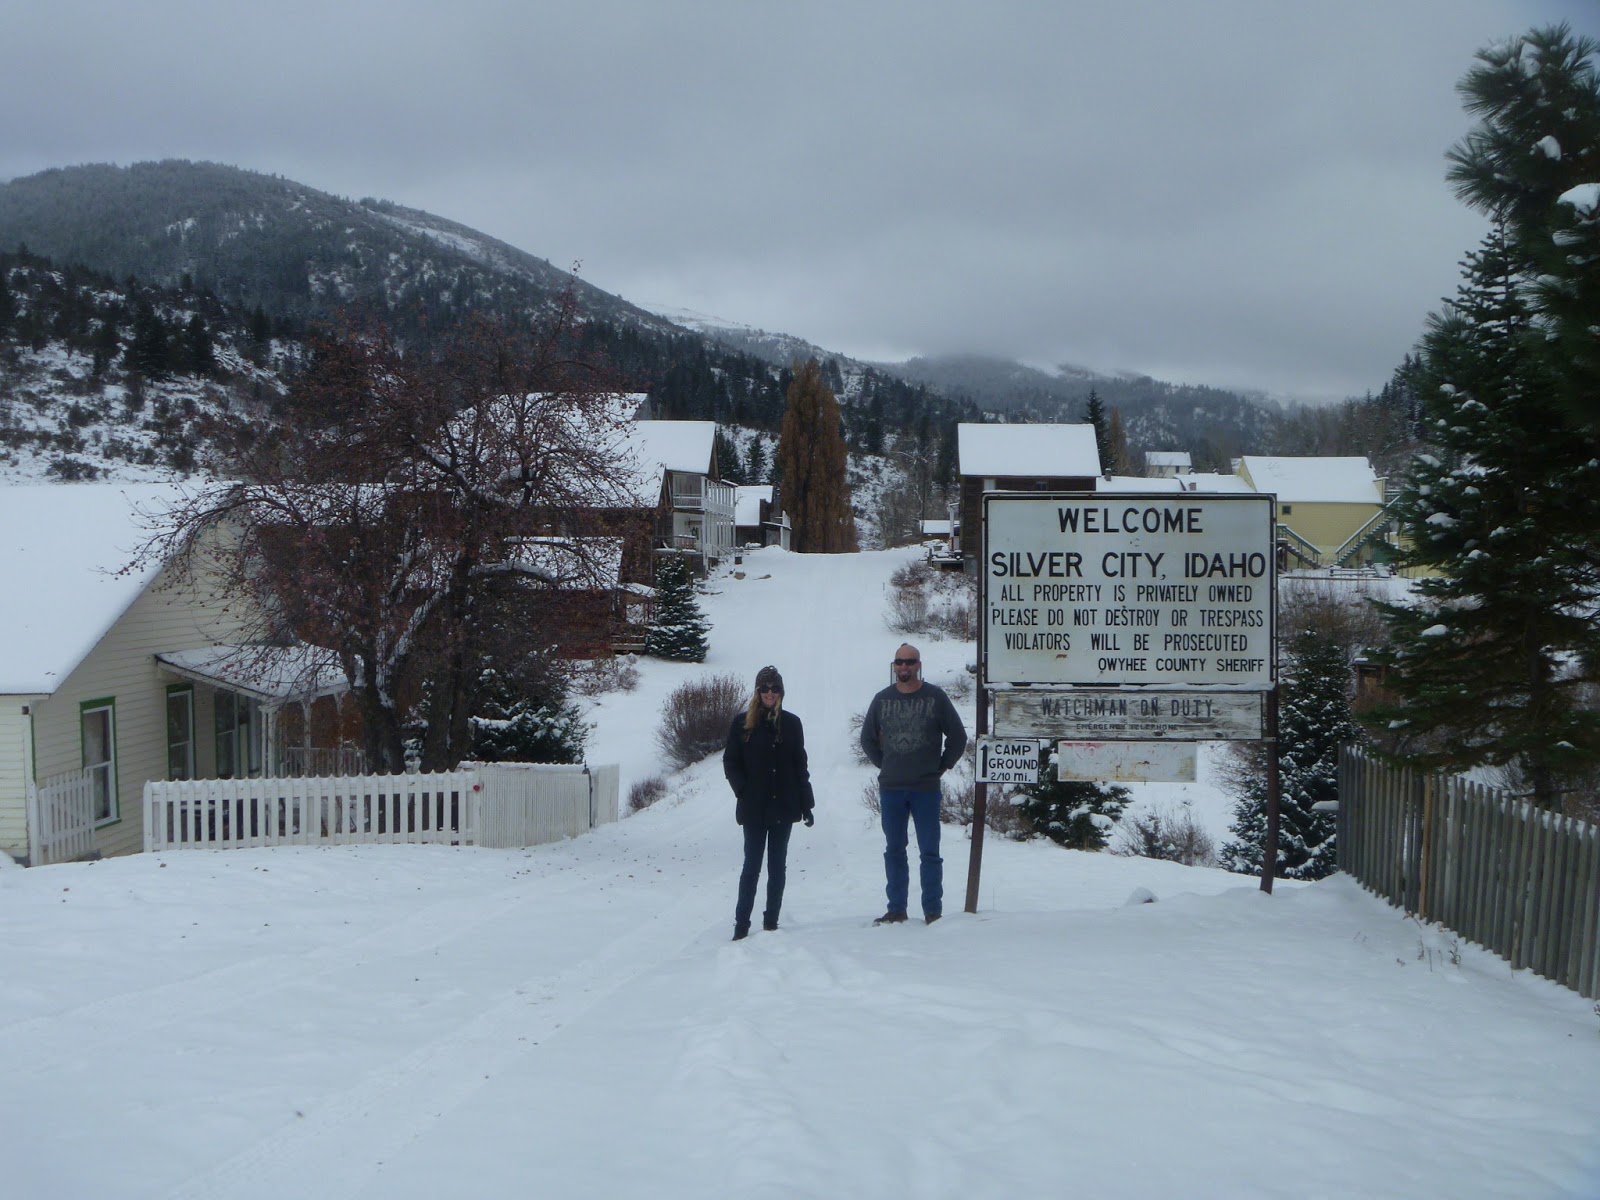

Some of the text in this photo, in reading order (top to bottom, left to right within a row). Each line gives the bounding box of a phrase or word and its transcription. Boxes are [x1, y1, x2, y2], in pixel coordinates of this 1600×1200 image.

[1057, 507, 1203, 534] WELCOME
[991, 552, 1266, 580] SILVER CITY, IDAHO
[1001, 584, 1252, 602] ALL PROPERTY IS PRIVATELY OWNED
[992, 609, 1264, 627] PLEASE DO NOT DESTROY OR TRESPASS
[1004, 633, 1248, 651] VIOLATORS WILL BE PROSECUTED
[1098, 658, 1265, 672] OWYHEE COUNTY SHERIFF
[1042, 698, 1213, 717] WATCHMAN ON DUTY
[994, 744, 1032, 756] CAMP
[988, 758, 1038, 770] GROUND
[990, 771, 1011, 782] 2/10
